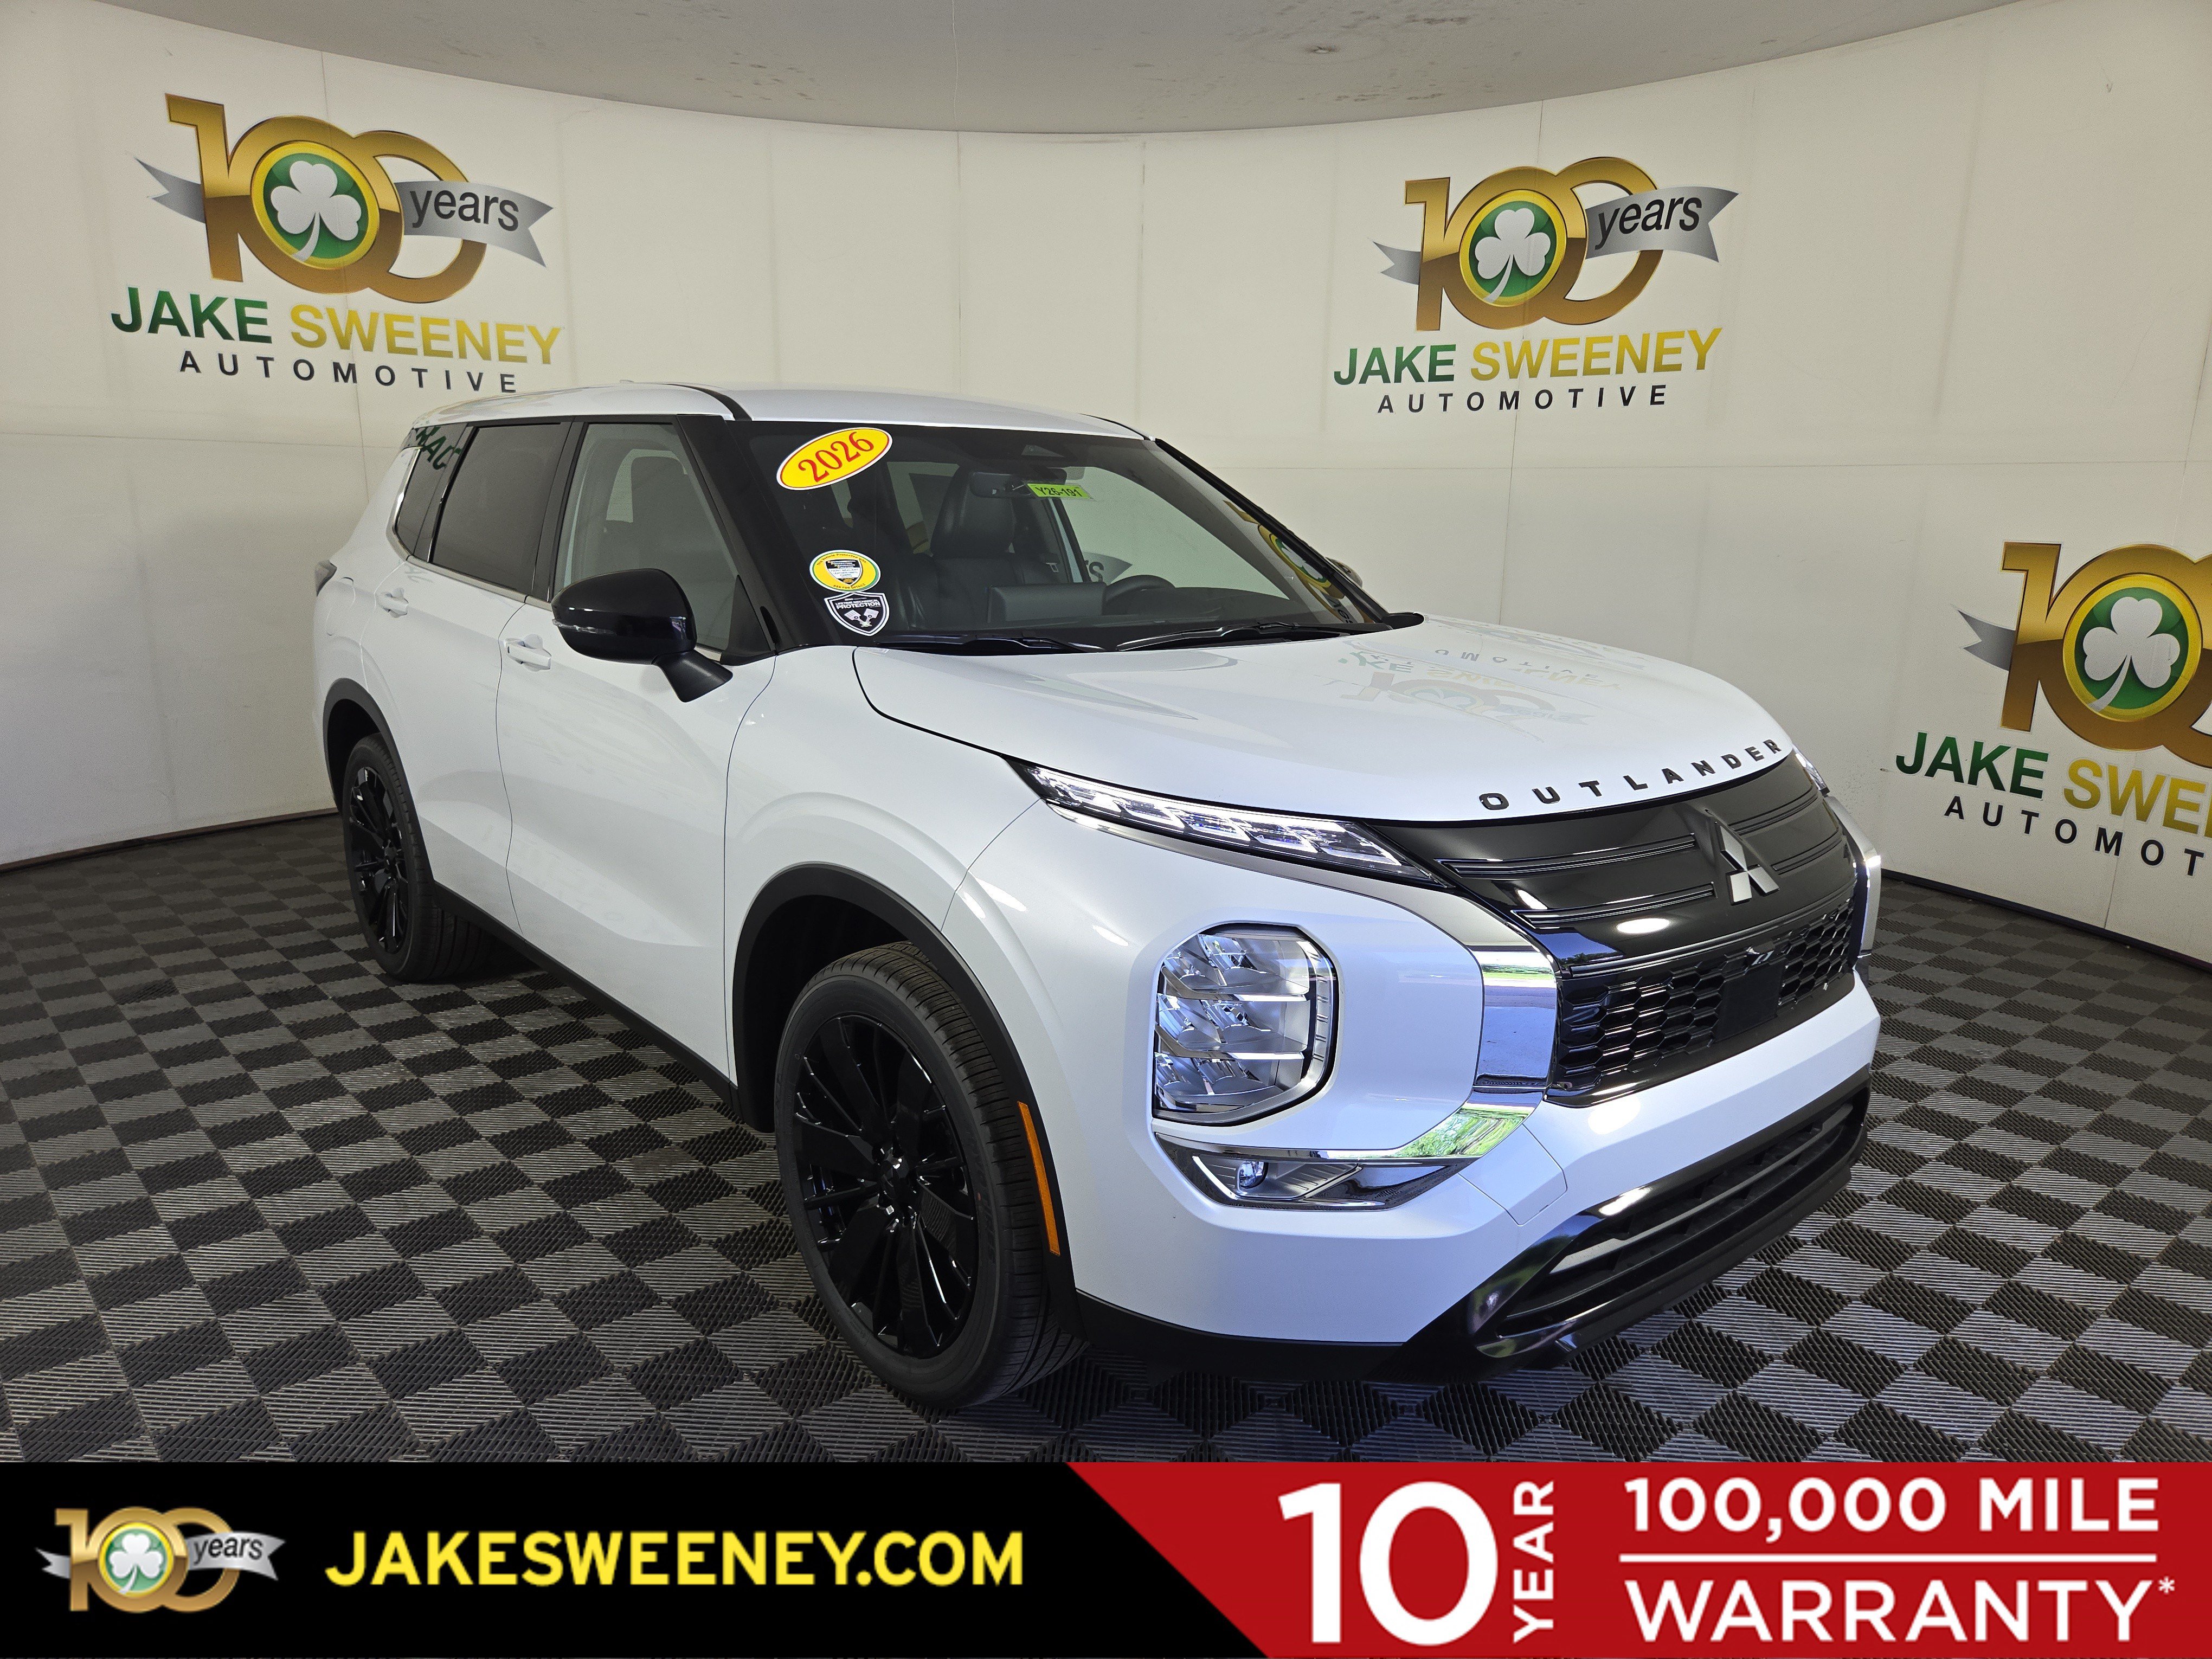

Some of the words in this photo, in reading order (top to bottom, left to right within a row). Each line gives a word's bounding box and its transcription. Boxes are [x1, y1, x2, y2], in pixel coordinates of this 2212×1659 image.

[165, 93, 487, 304] 100
[410, 188, 520, 232] years
[1405, 157, 1664, 331] 100
[1594, 196, 1703, 251] years
[111, 286, 273, 344] JAKE
[290, 304, 563, 365] SWEENEY
[1334, 344, 1456, 386] JAKE
[1470, 326, 1723, 381] SWEENEY
[179, 350, 517, 394] AUTOMOTIVE
[1377, 384, 1668, 414] AUTOMOTIVE
[798, 431, 874, 483] 2026
[1034, 486, 1083, 497] Y26-191
[836, 602, 881, 610] PROTECTION
[1999, 542, 2212, 769] 10
[1478, 738, 1782, 812] OUTLANDER
[1895, 731, 2049, 800] JAKE
[2063, 758, 2212, 839] SWE
[1944, 795, 2205, 877] AUTOMOT
